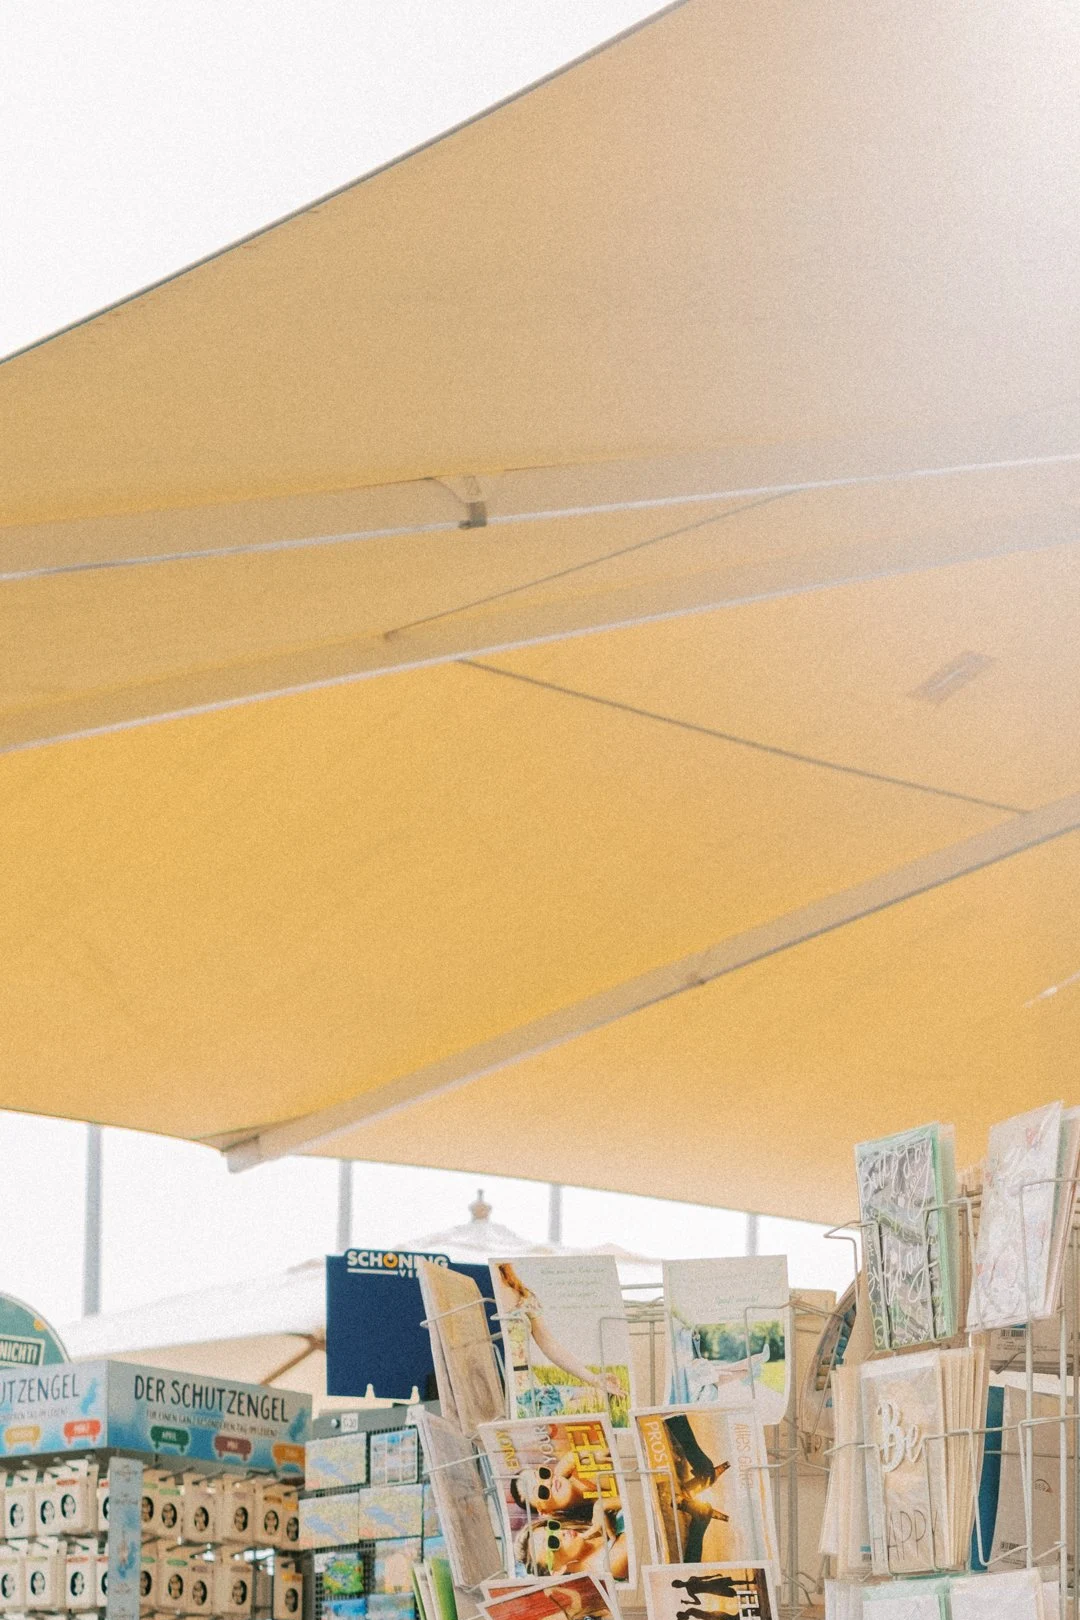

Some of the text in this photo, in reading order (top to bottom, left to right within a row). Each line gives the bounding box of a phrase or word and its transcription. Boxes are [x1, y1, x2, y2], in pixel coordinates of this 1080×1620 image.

[134, 1375, 290, 1424] DER SCHUTZENGEL
[535, 1424, 557, 1468] YOUR
[565, 1423, 619, 1500] LIFE!
[876, 1400, 925, 1473] Be
